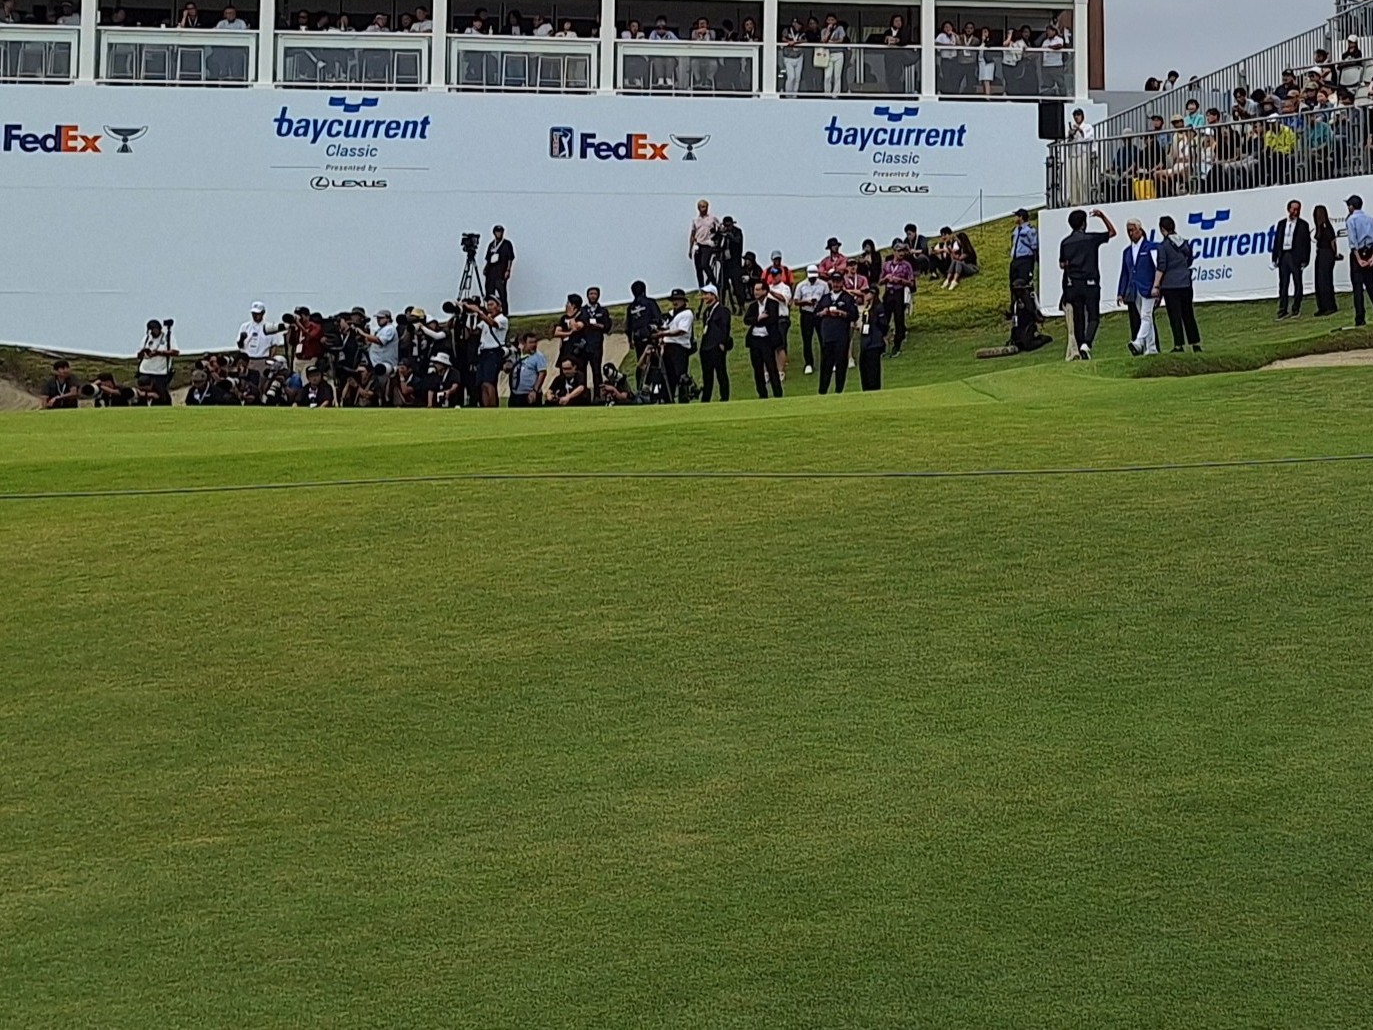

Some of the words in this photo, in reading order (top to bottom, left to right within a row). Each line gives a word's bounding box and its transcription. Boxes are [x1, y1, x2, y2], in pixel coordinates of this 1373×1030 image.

[273, 106, 431, 145] baycurrent
[3, 124, 102, 153] FedEx
[824, 116, 967, 151] baycurrent
[326, 144, 378, 157] Classic
[579, 133, 669, 160] FedEx
[873, 151, 920, 164] Classic
[325, 164, 366, 172] Presented
[367, 165, 378, 174] by
[332, 180, 388, 188] LEXUS
[879, 185, 930, 194] LEXUS
[1190, 264, 1233, 282] Classic
